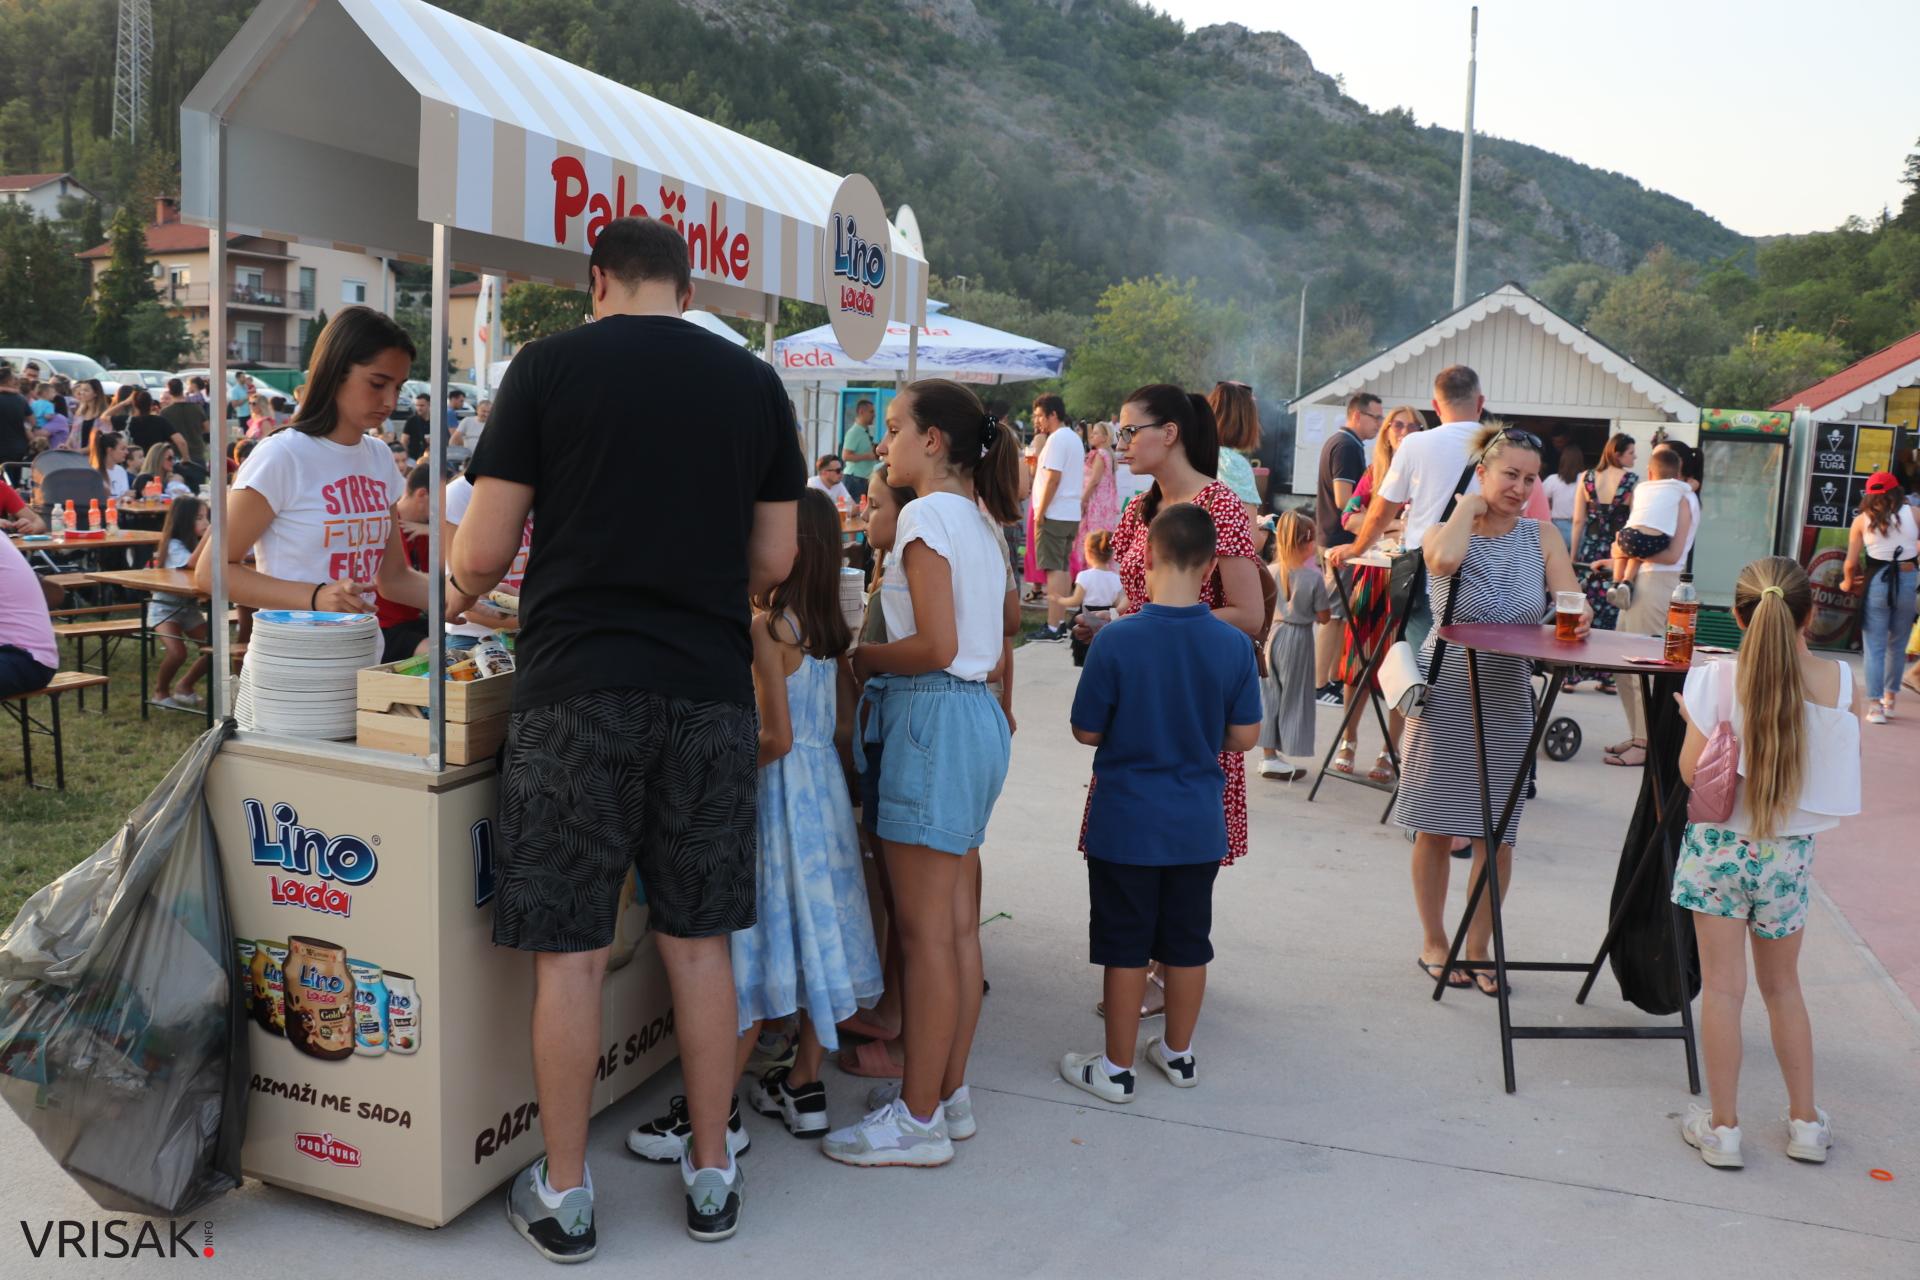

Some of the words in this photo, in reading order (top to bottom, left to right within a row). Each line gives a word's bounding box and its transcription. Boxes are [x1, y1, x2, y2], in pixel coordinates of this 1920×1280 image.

[833, 212, 886, 289] Lino
[840, 284, 875, 317] Lada
[783, 348, 835, 369] leda
[1819, 461, 1845, 470] TURA
[1820, 453, 1846, 462] COOL
[321, 475, 389, 515] STREET
[1813, 506, 1839, 515] COOL
[1813, 513, 1838, 522] TURA
[329, 548, 384, 583] FEST
[243, 798, 377, 887] Lino
[268, 874, 351, 918] Lada
[300, 965, 345, 994] Lino
[306, 990, 336, 1004] Lada
[389, 989, 411, 1009] ino
[321, 1011, 341, 1020] Gold
[623, 1007, 674, 1067] SADA
[250, 1073, 317, 1106] AZMAŽI
[321, 1094, 352, 1114] ME
[356, 1102, 413, 1130] SADA
[300, 1138, 357, 1162] PODRAVKA
